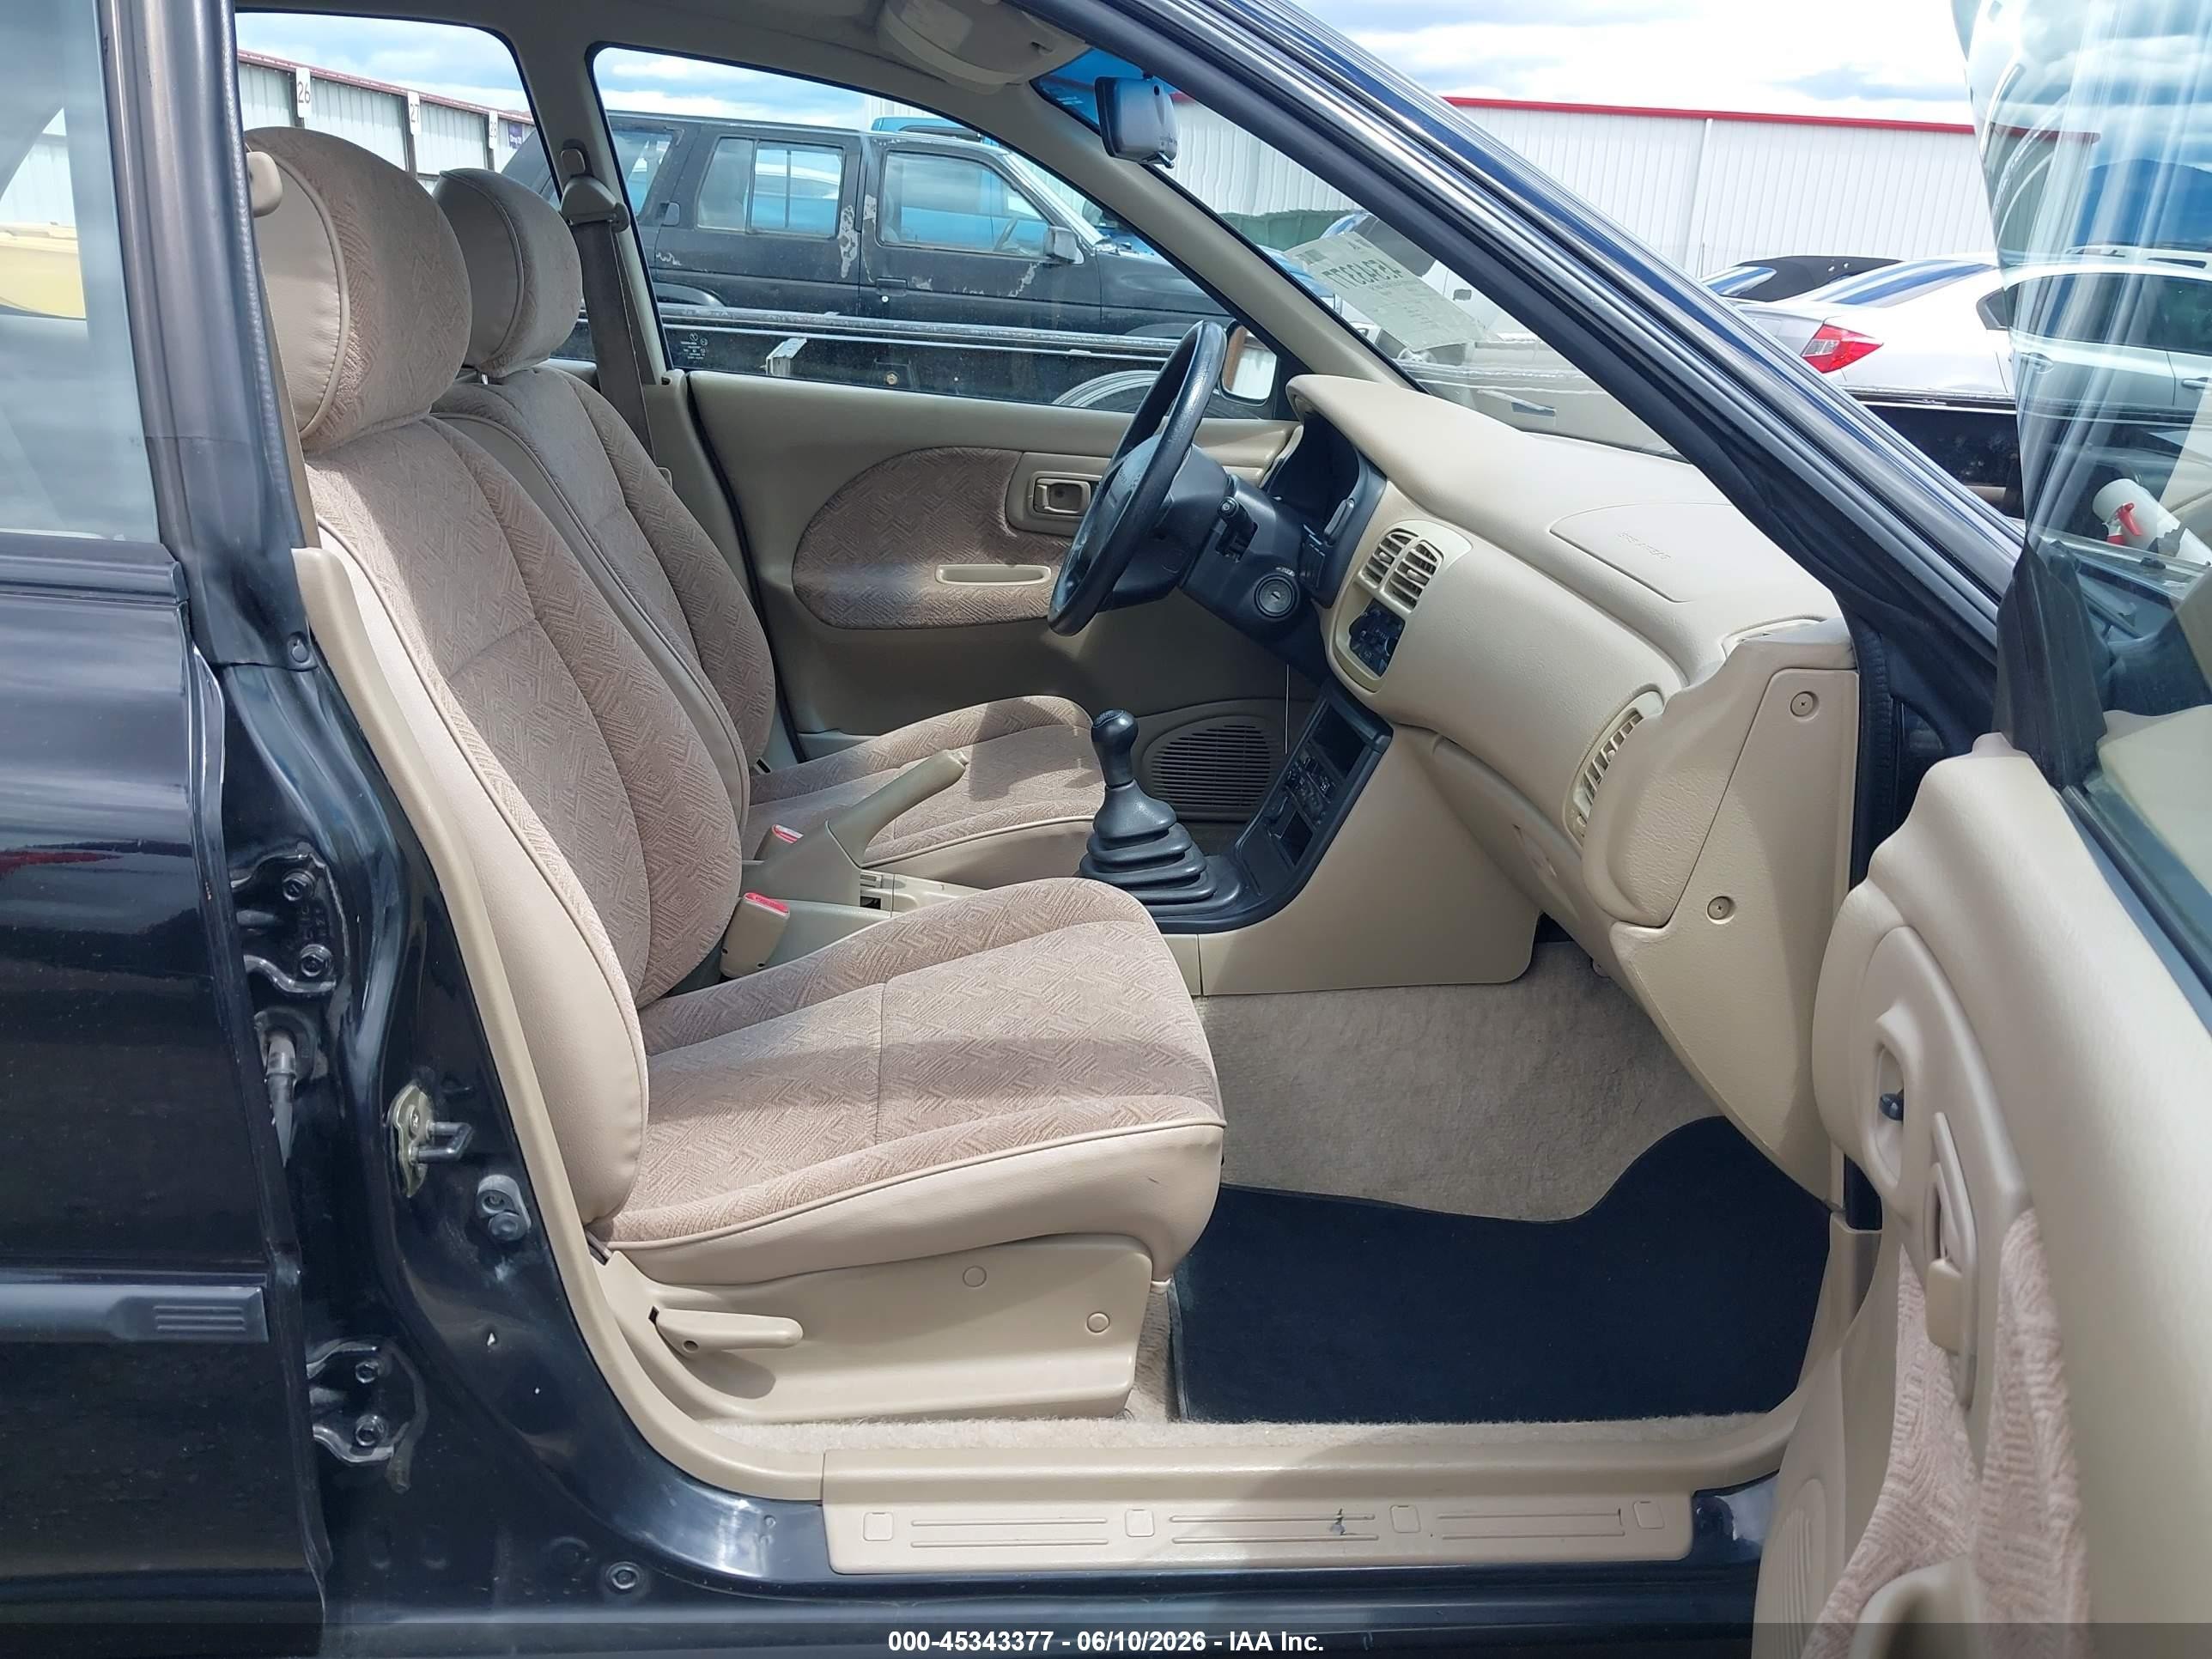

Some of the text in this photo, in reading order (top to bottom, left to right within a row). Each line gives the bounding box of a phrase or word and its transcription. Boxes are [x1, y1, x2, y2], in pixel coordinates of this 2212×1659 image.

[296, 81, 311, 104] 26
[410, 103, 420, 124] 27
[489, 121, 497, 137] 28
